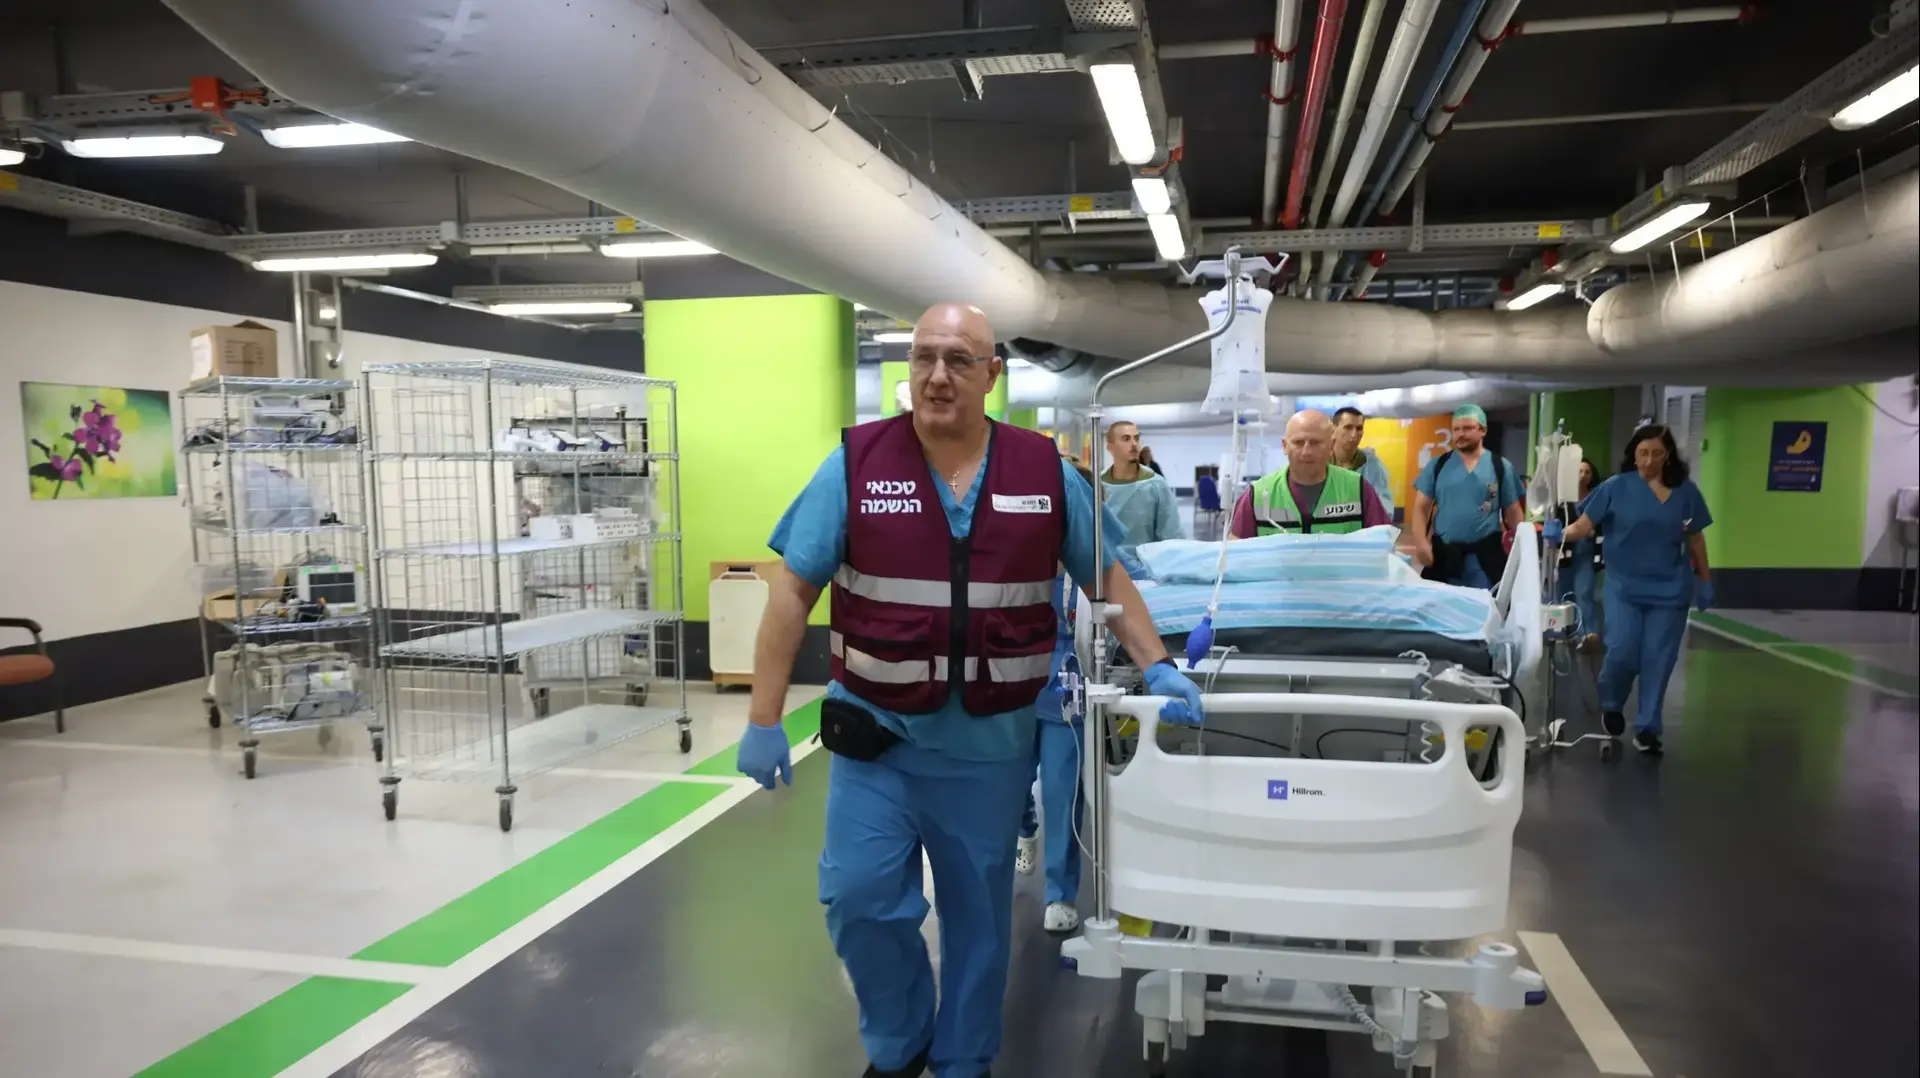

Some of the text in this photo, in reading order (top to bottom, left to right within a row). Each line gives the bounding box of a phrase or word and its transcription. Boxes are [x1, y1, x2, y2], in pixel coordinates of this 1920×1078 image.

[866, 480, 916, 495] טכנאי
[861, 498, 922, 514] הנשמה
[1326, 504, 1355, 516] שינוע
